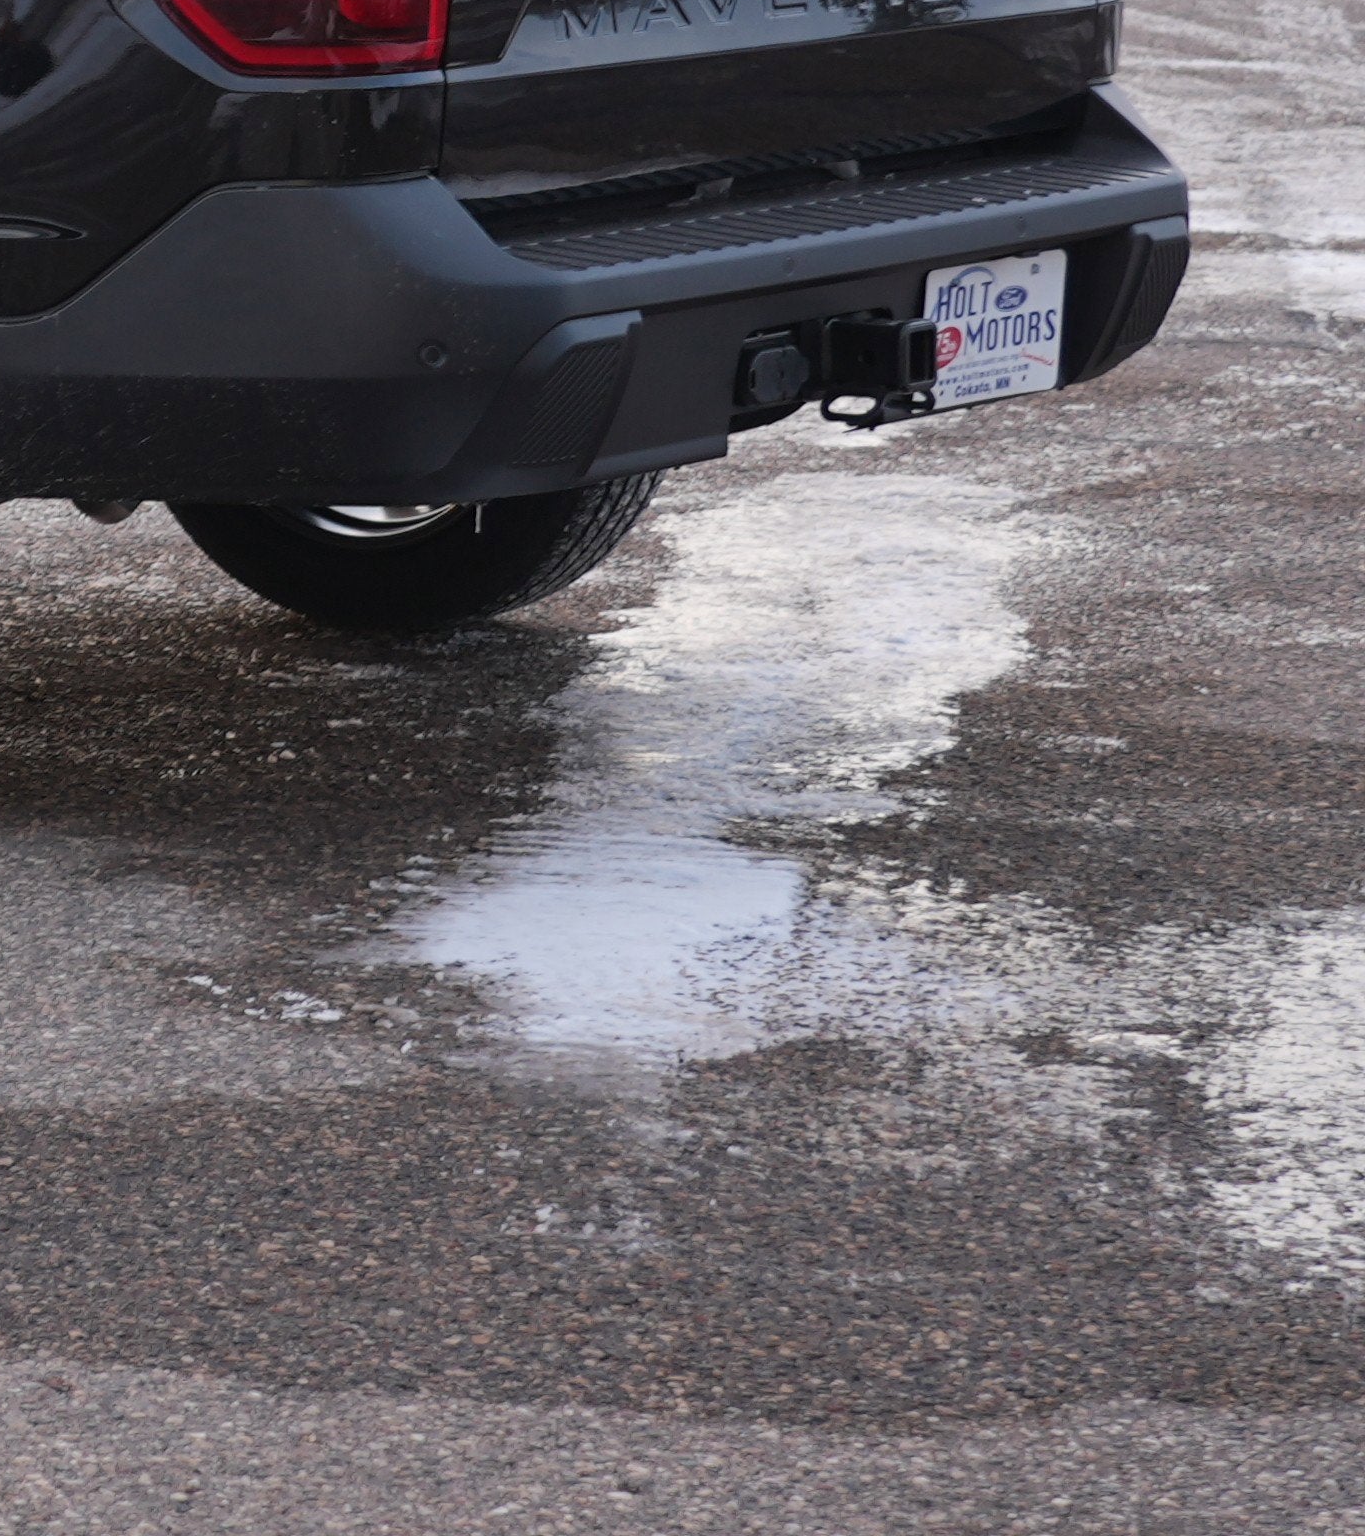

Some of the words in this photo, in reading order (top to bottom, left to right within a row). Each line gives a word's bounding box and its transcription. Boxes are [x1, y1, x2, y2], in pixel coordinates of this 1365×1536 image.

[936, 281, 993, 323] HOLT
[964, 309, 1057, 356] MOTORS
[955, 380, 993, 399] Cokato,
[995, 375, 1011, 390] MN
